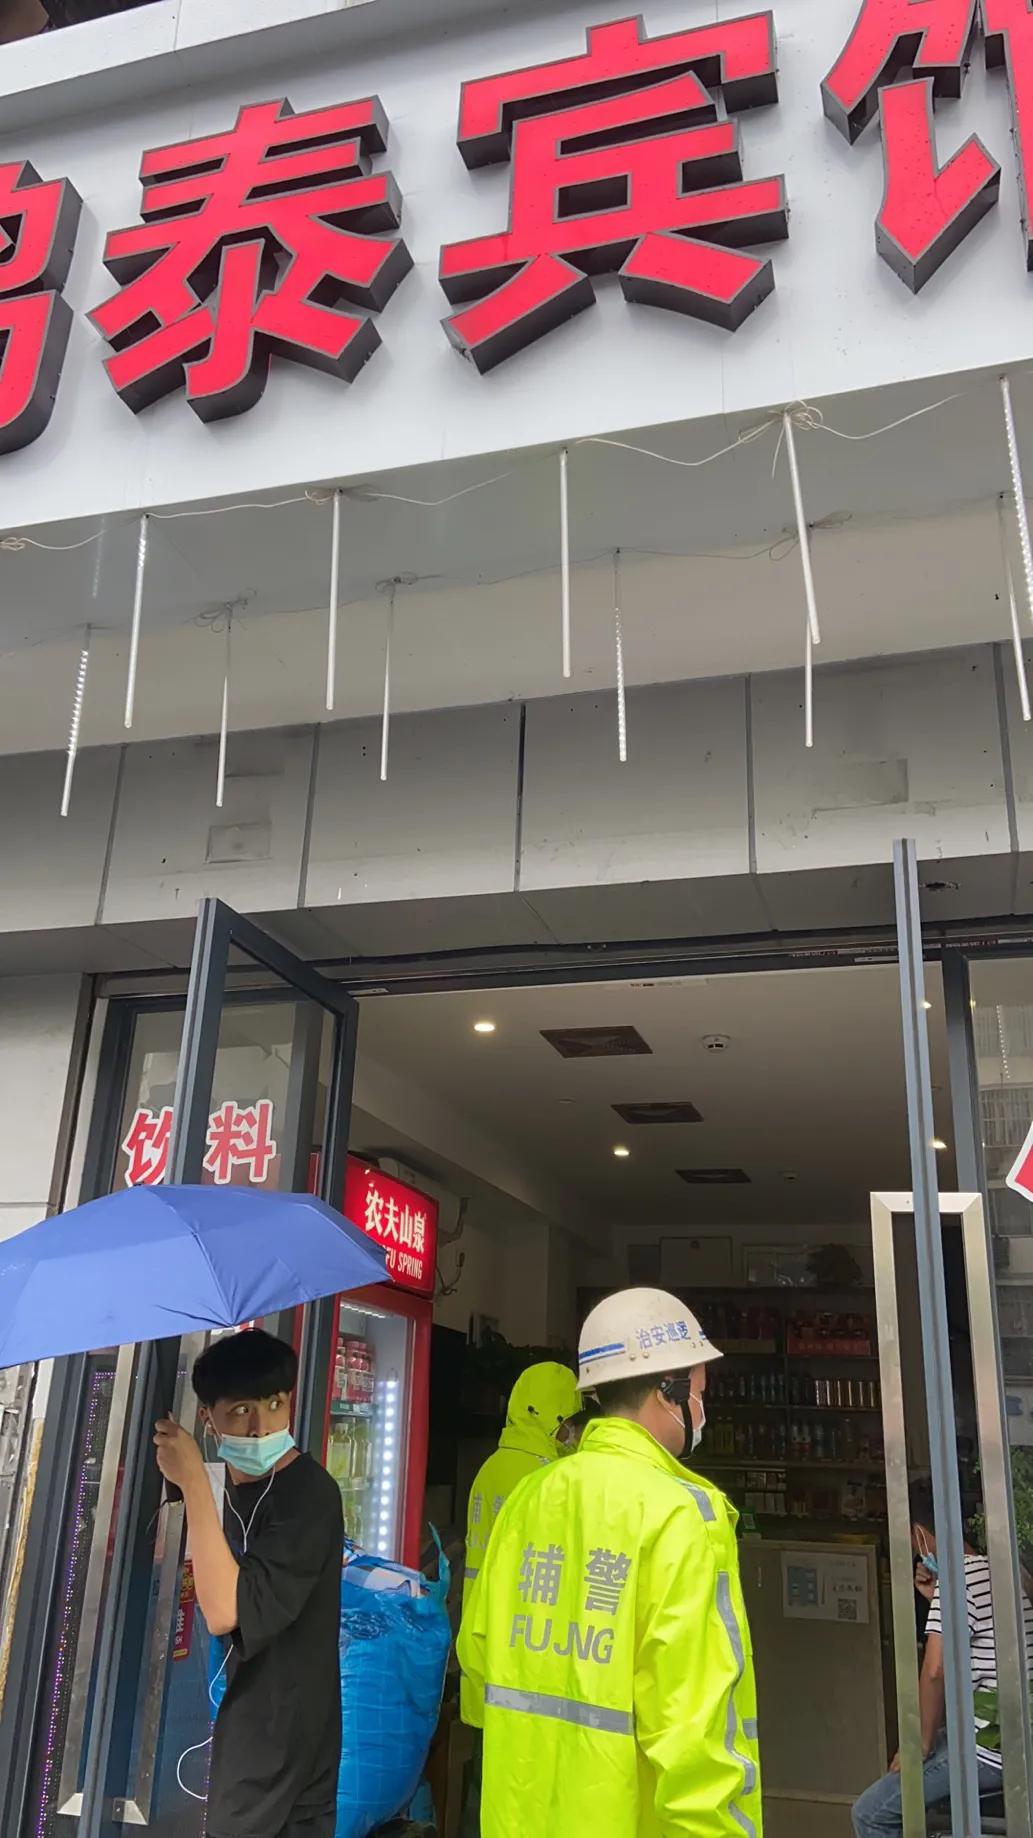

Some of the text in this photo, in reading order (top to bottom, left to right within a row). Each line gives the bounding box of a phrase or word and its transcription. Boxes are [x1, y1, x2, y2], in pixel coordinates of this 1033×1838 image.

[365, 1189, 425, 1254] 农夫山泉
[397, 1252, 422, 1280] SPRING
[518, 1541, 632, 1615] 辅警
